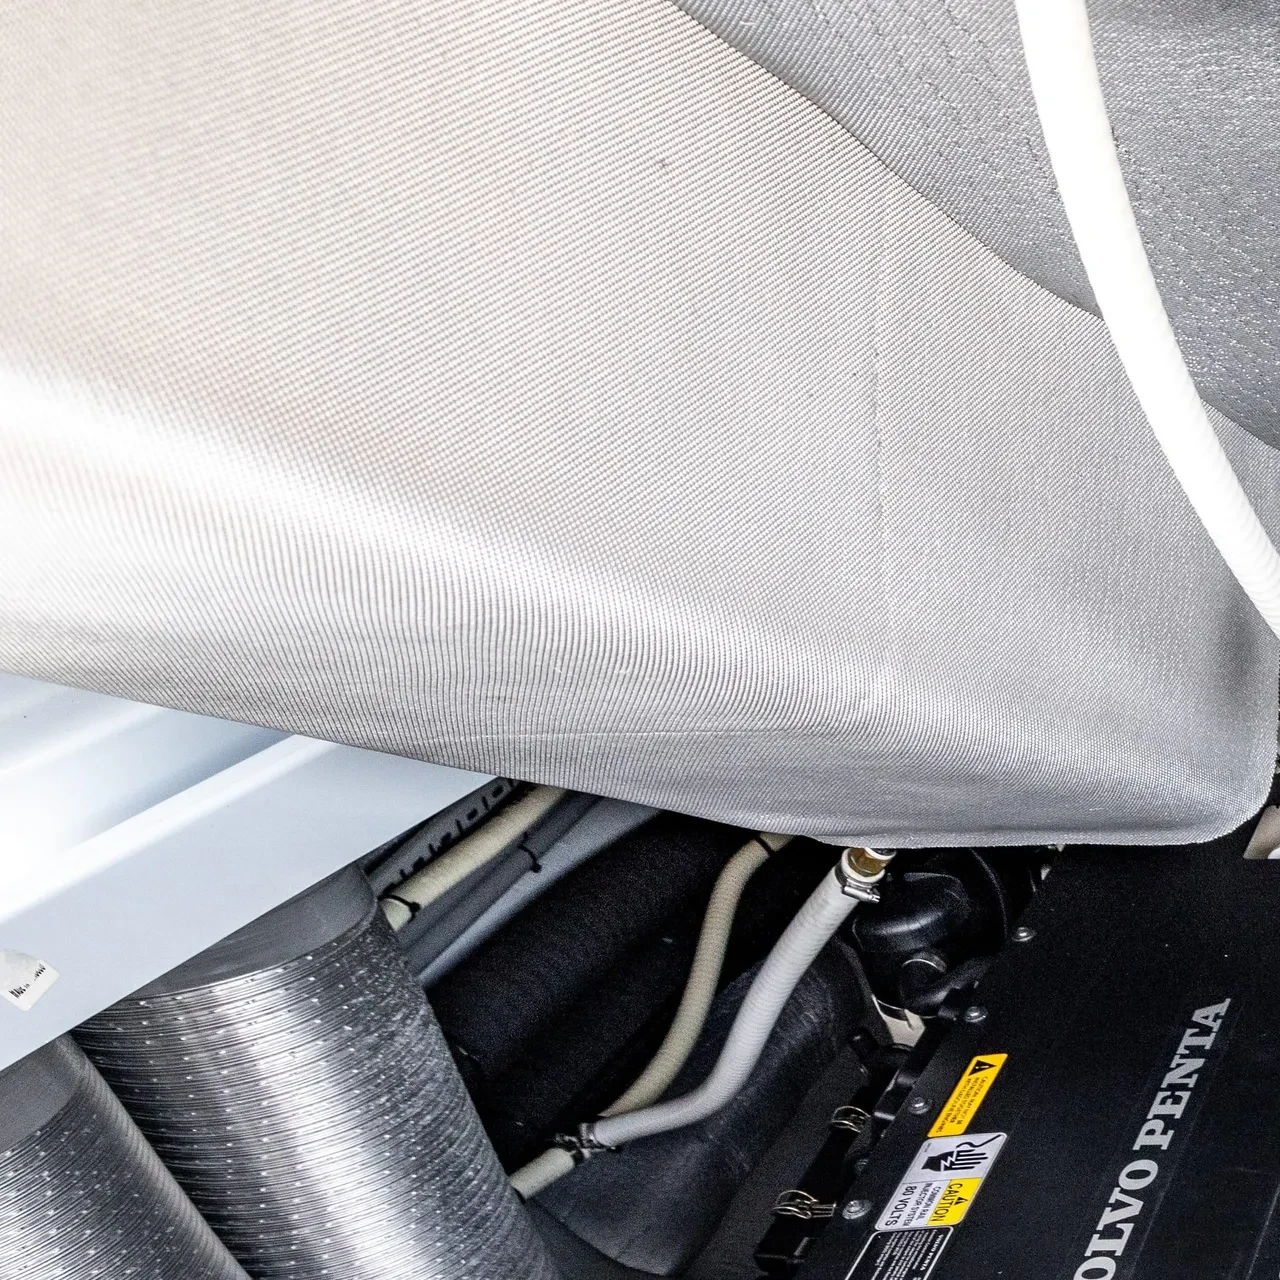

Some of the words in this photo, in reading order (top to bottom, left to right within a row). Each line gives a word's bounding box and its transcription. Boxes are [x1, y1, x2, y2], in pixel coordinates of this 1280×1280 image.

[1132, 998, 1231, 1150] PENTA
[902, 1185, 917, 1196] 80
[932, 1183, 963, 1222] CAUTION
[885, 1197, 909, 1226] VOLTS
